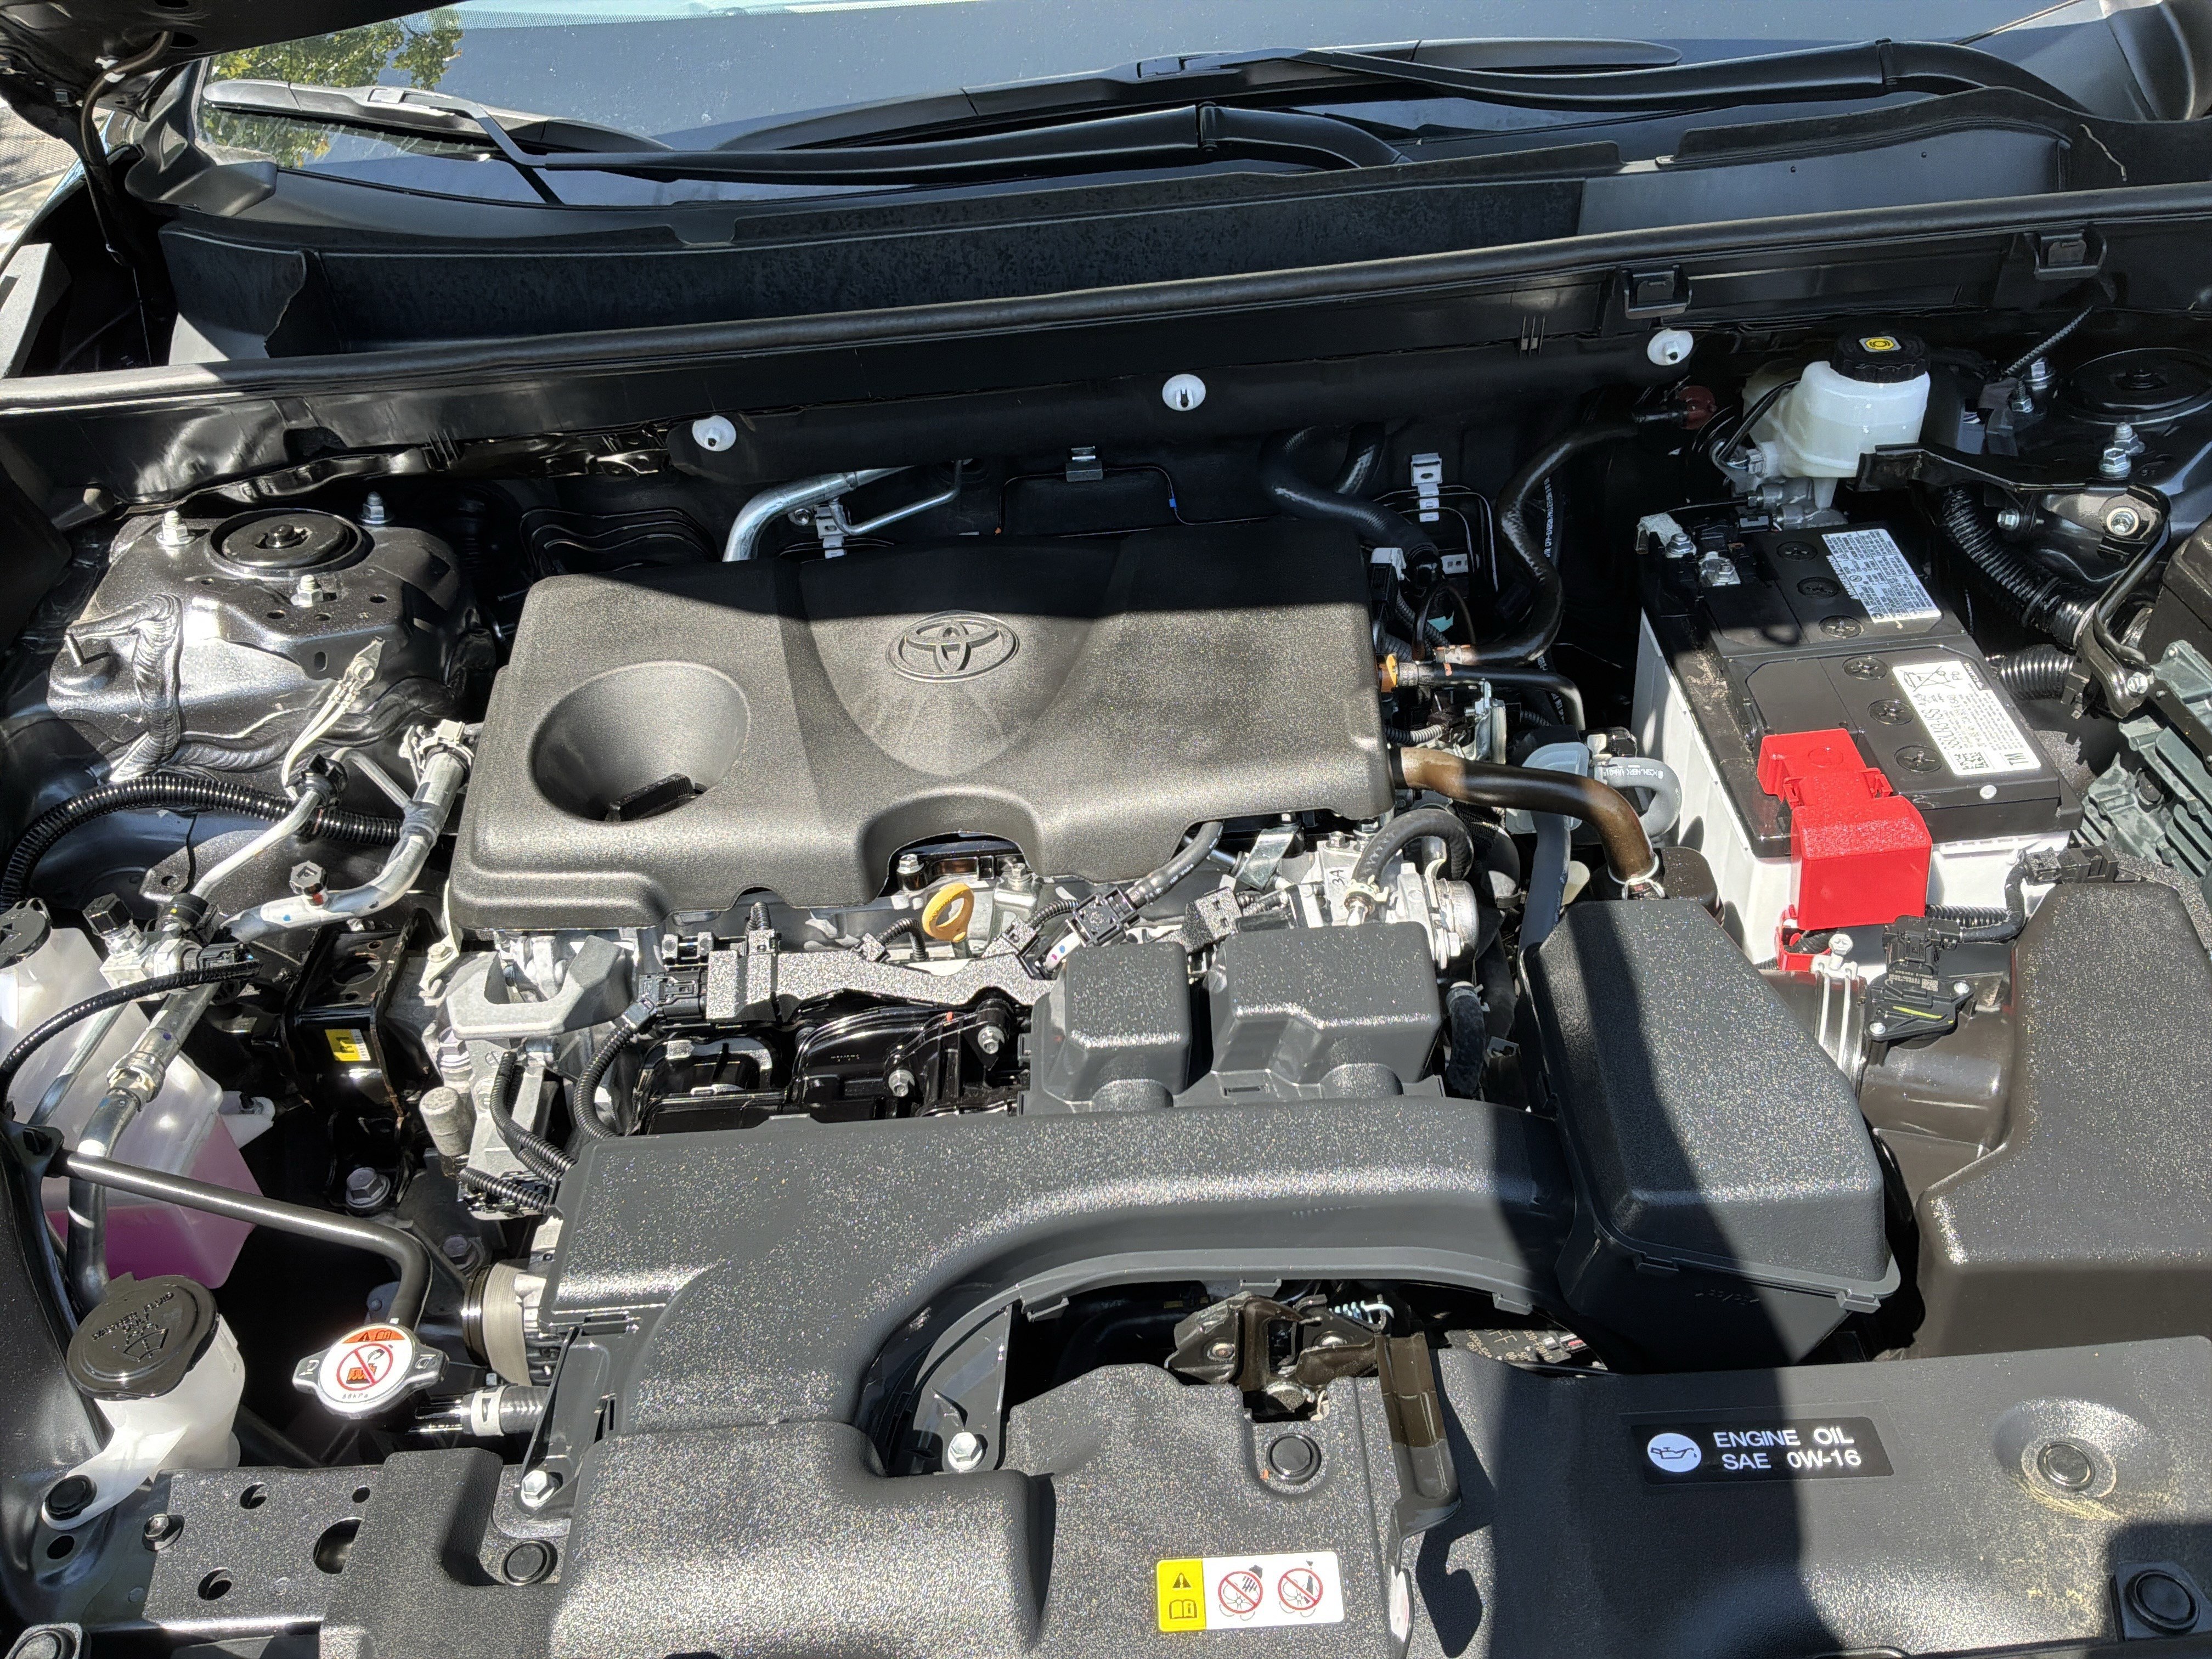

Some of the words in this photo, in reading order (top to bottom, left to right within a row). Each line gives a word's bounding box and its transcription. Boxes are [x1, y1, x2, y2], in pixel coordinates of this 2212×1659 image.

[1950, 671, 1963, 681] Pb
[336, 1036, 354, 1053] R1
[1713, 1429, 1801, 1447] ENGINE
[1813, 1427, 1854, 1445] OIL
[1722, 1452, 1771, 1470] SAE
[1787, 1450, 1861, 1468] 0W-16
